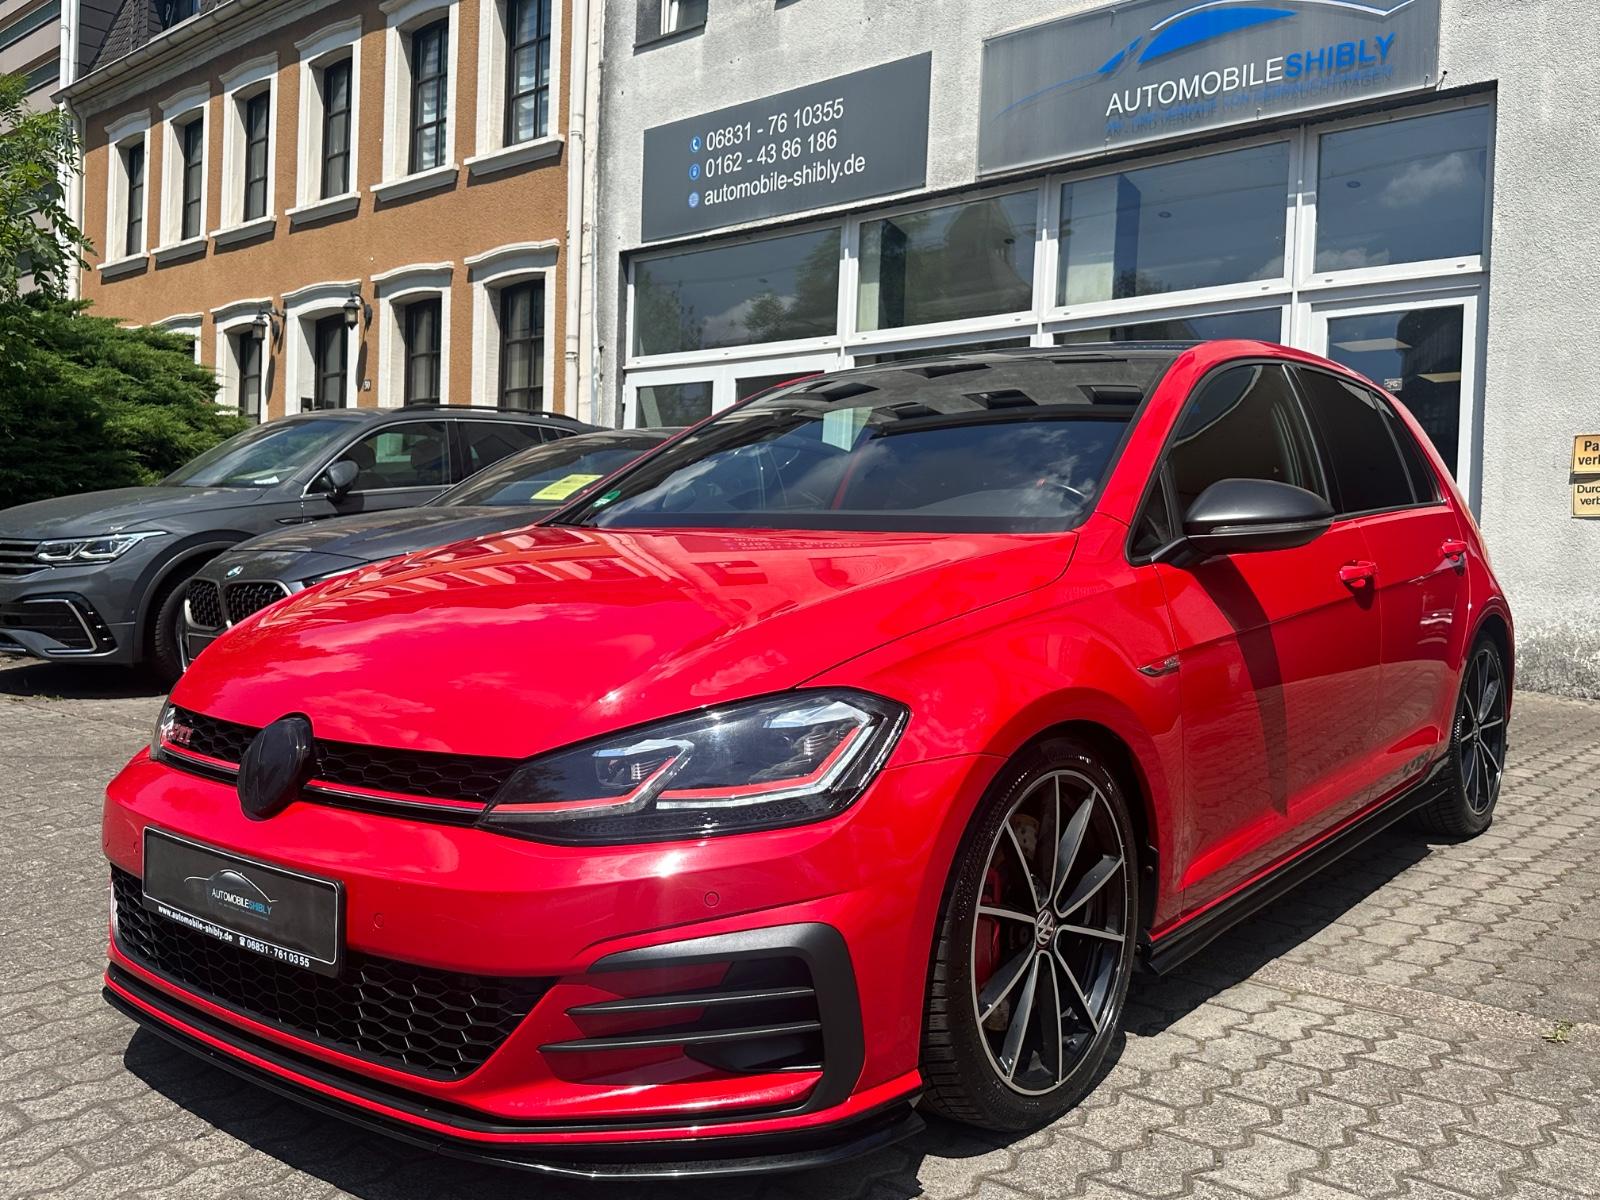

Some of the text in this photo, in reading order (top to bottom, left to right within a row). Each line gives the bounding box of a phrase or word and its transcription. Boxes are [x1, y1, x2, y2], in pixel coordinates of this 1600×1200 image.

[1105, 31, 1397, 117] AUTOMOBILESHIBLY
[706, 121, 751, 152] 06831
[768, 113, 788, 136] 76
[793, 98, 844, 129] 10355
[705, 153, 742, 178] 0162
[757, 144, 777, 165] 43
[781, 138, 802, 161] 86
[807, 129, 837, 153] 186
[704, 153, 866, 206] automobile-shibly.de
[211, 888, 272, 915] AUTOMOBILESHIBLY
[158, 905, 233, 942] www.automobile-shibly.de
[246, 939, 269, 954] 06831
